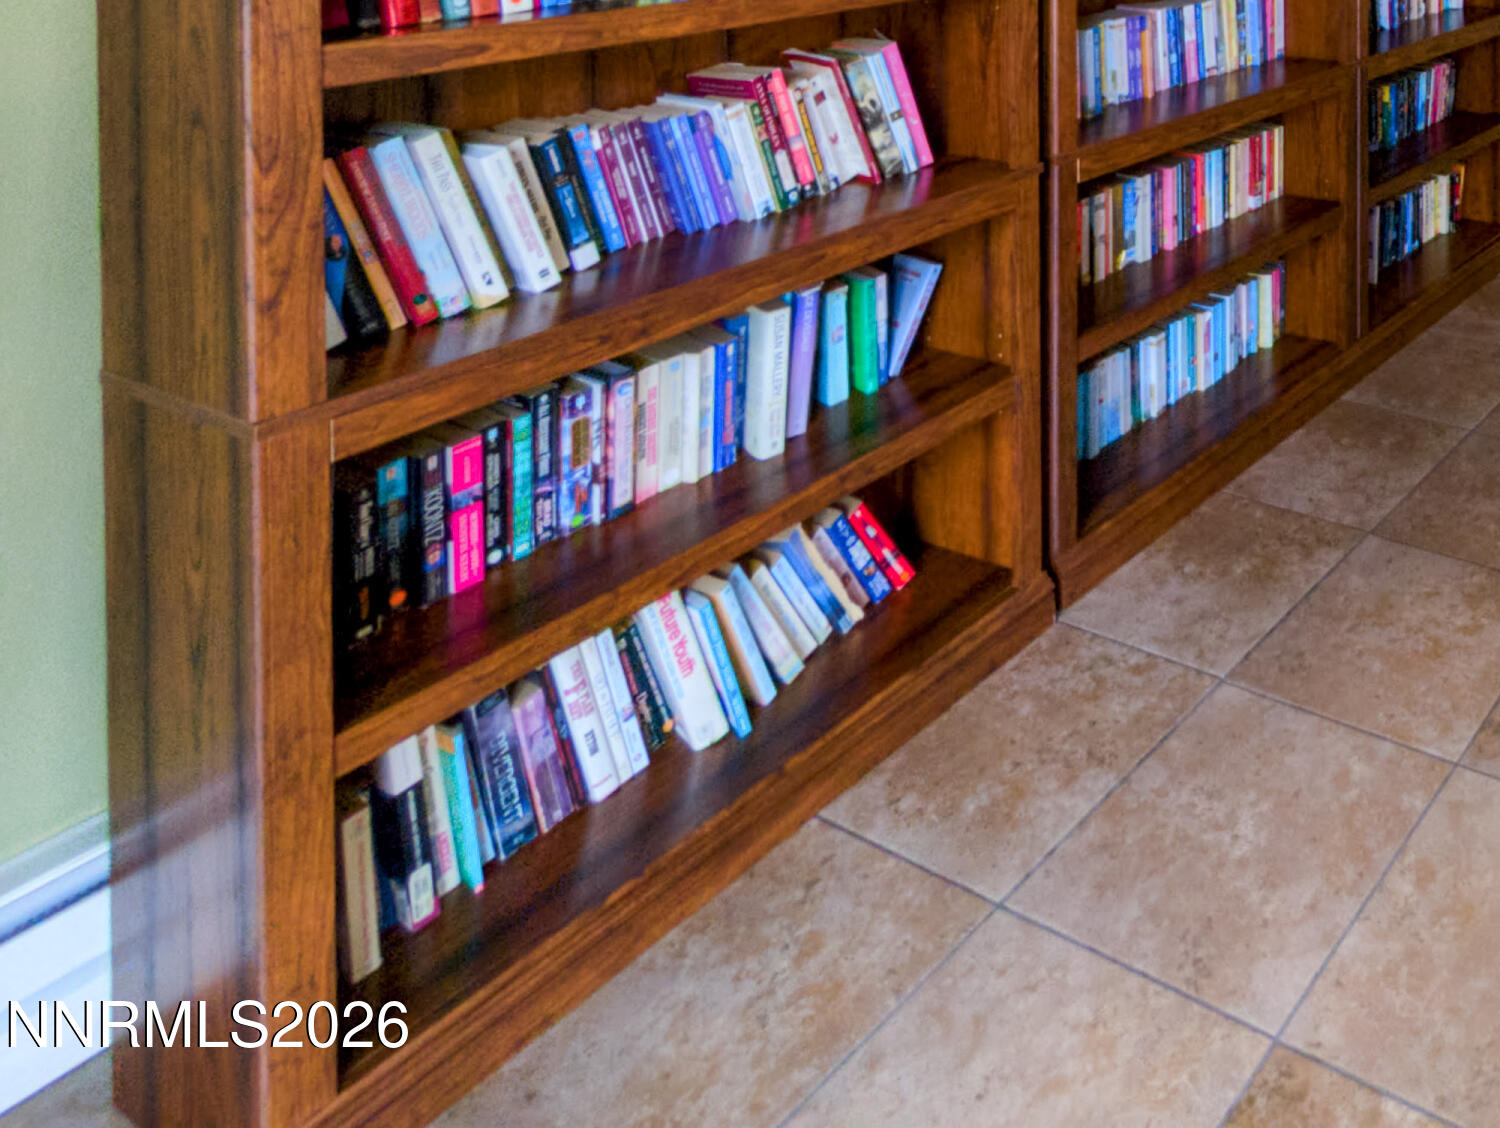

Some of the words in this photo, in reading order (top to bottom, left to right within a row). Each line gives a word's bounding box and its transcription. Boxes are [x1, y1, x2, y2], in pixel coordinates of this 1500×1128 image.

[773, 314, 786, 349] SUSAN
[772, 352, 786, 397] MALLERY
[423, 483, 444, 546] KOONTZ
[656, 592, 683, 642] Future
[672, 635, 697, 678] Youth
[488, 730, 524, 825] DIVERGENT
